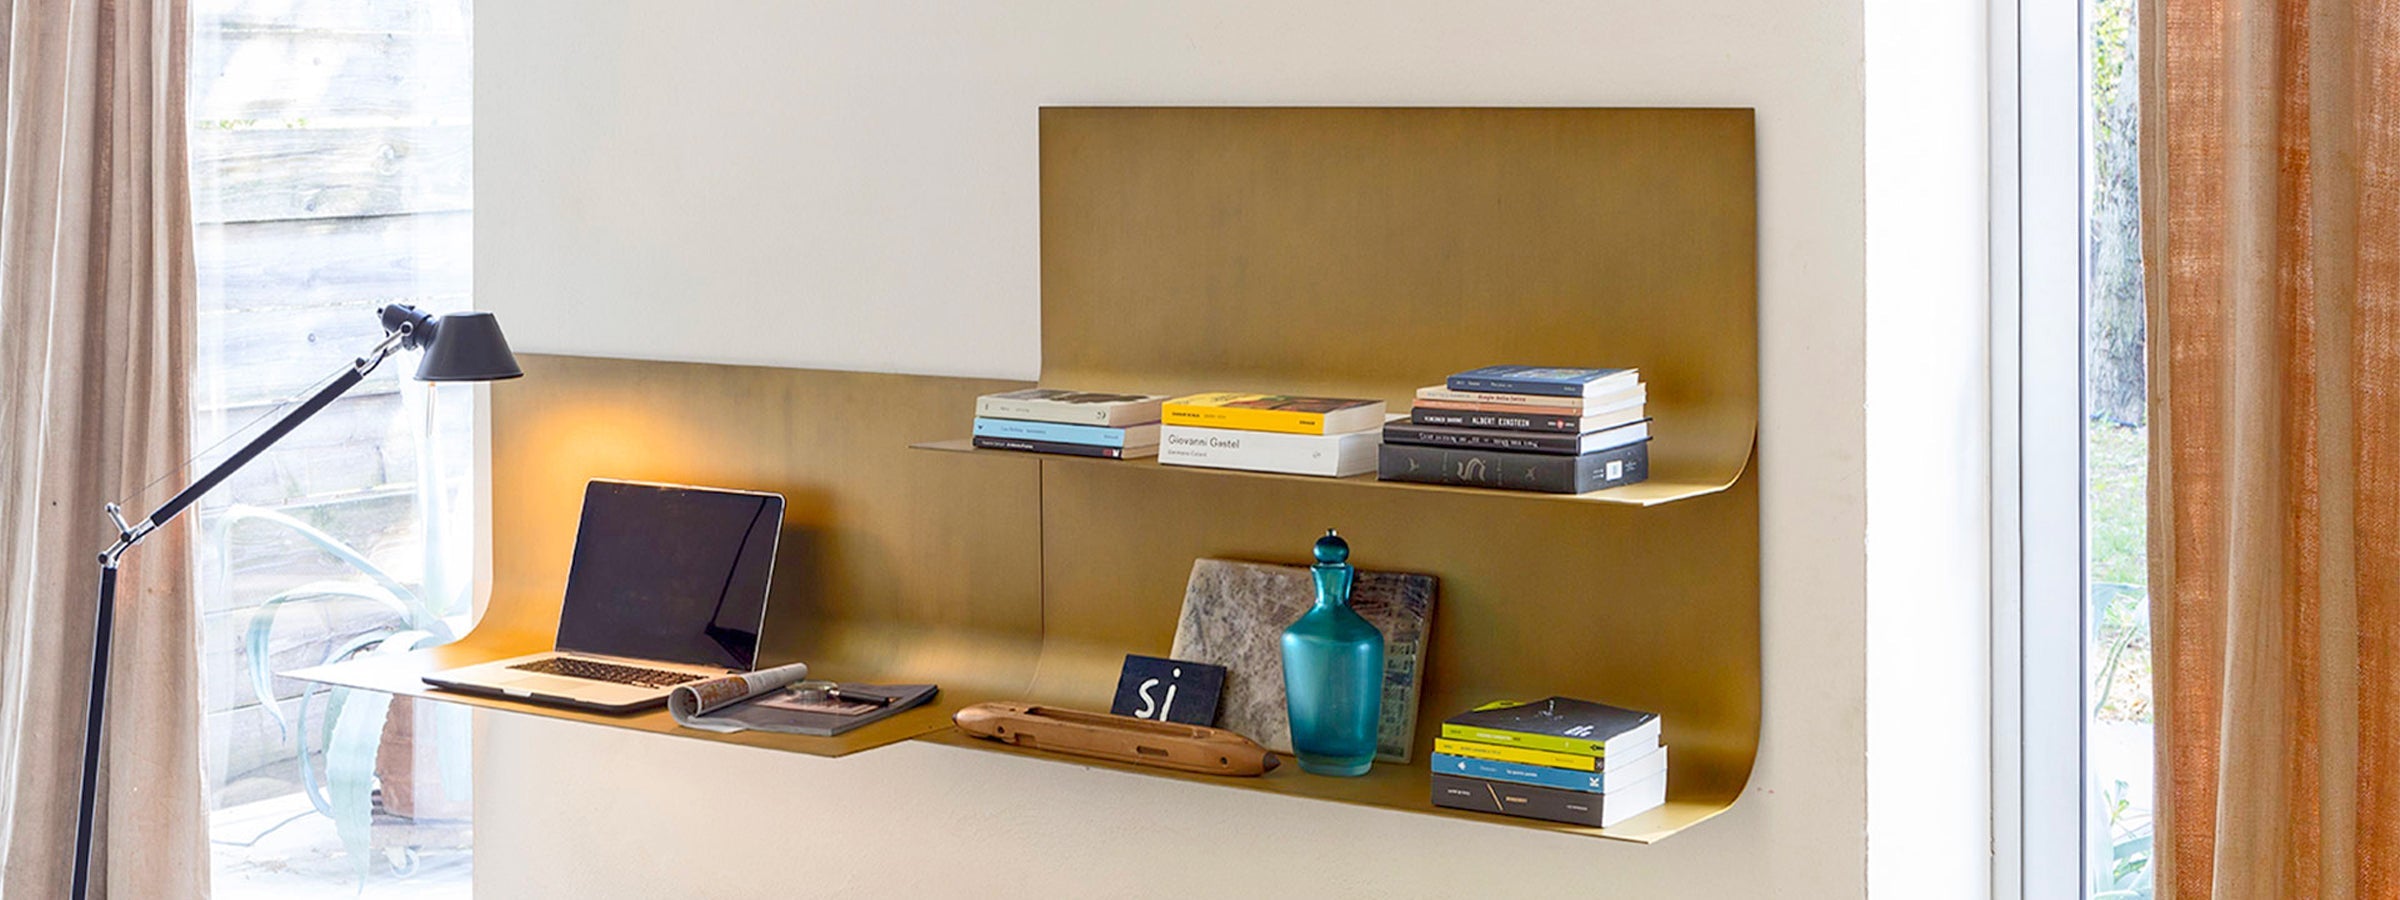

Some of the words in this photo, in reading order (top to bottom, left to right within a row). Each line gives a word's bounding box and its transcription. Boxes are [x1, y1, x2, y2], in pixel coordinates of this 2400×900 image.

[1472, 416, 1495, 425] ALBERT
[1498, 417, 1530, 427] EINSTEIN
[1168, 434, 1207, 447] Giovanni
[1209, 436, 1240, 449] Gastel
